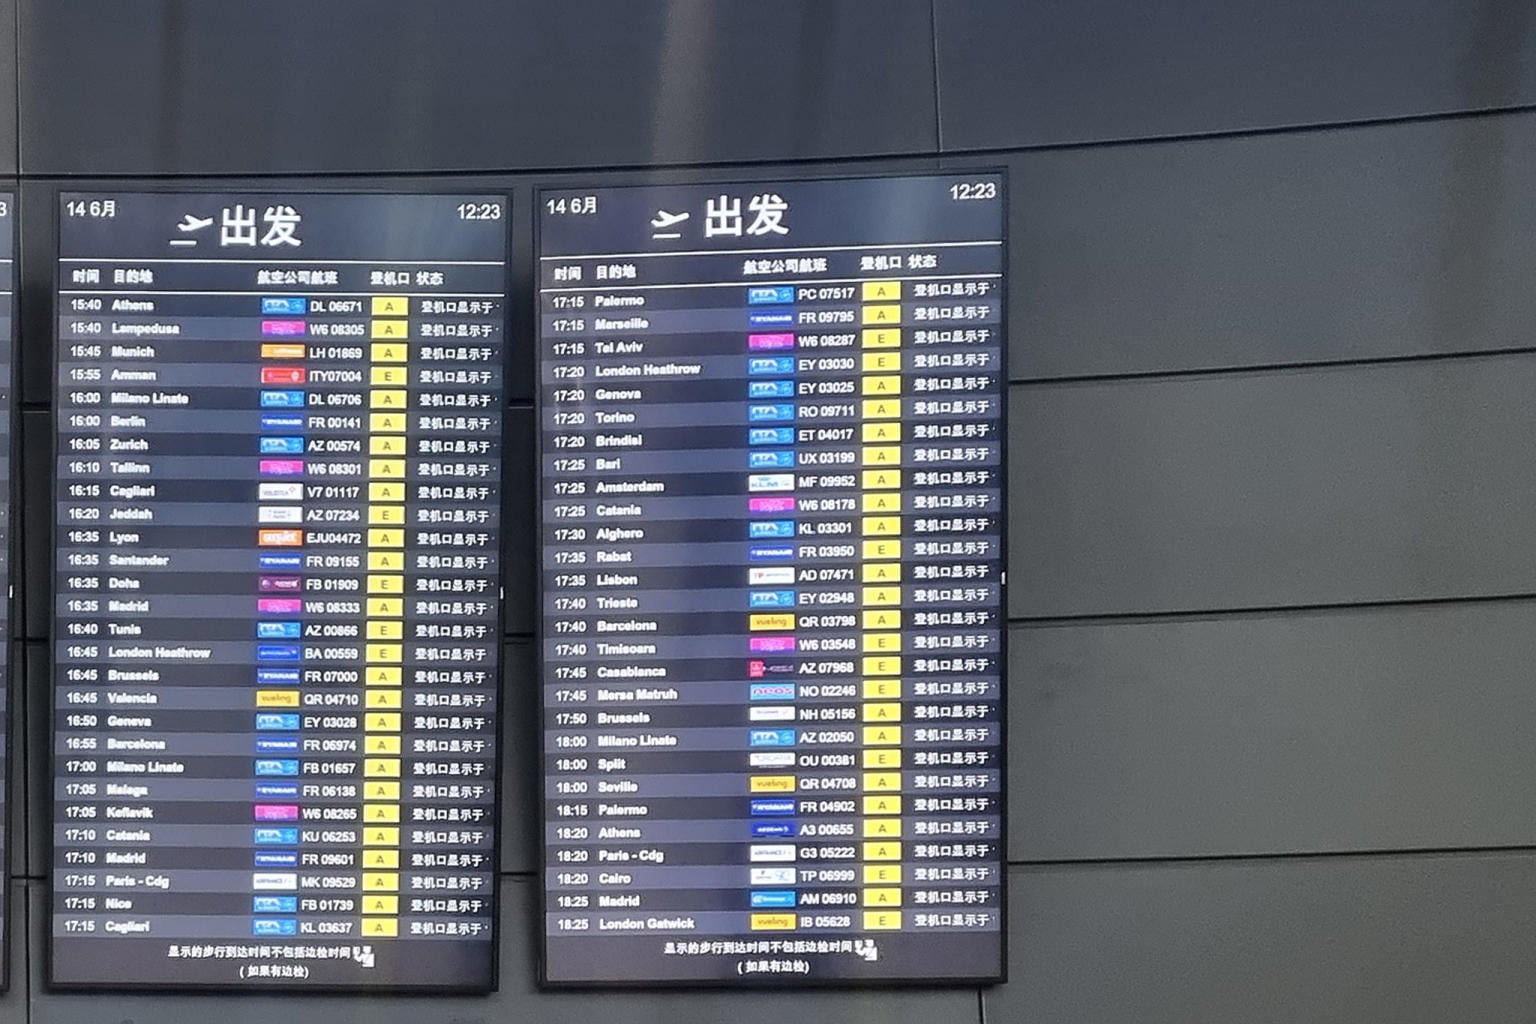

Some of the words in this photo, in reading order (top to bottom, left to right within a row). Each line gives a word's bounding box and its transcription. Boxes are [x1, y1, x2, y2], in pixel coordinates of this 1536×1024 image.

[951, 183, 995, 199] 12:23
[67, 202, 85, 216] 14
[90, 201, 114, 217] 6月
[458, 204, 500, 219] 12:23
[547, 199, 566, 214] 14
[571, 197, 596, 213] 6月
[706, 195, 788, 237] 出发
[221, 205, 301, 246] 出发
[555, 267, 581, 280] 时间
[597, 265, 636, 279] 目的地
[908, 255, 936, 269] 状态
[73, 269, 99, 283] 时间
[114, 269, 153, 283] 目的地
[416, 272, 443, 285] 状态
[553, 297, 584, 307] 17:15
[799, 289, 817, 299] PC
[816, 288, 855, 299] 07517
[877, 287, 886, 296] A
[71, 299, 101, 310] 15:40
[311, 301, 326, 312] DL
[329, 301, 361, 312] 06671
[385, 302, 394, 312] A
[71, 346, 101, 356] 15:45
[553, 343, 584, 354] 17:15
[613, 342, 643, 352] Aviv
[554, 413, 584, 424] 17:20
[595, 413, 634, 423] Torino
[70, 439, 100, 449] 16:05
[308, 441, 328, 451] AZ
[327, 441, 360, 451] 00574
[69, 485, 99, 496] 16:15
[307, 487, 323, 497] V7
[326, 487, 359, 497] 01117
[555, 483, 585, 493] 17:25
[69, 531, 99, 542] 16:35
[555, 575, 585, 586] 17:35
[597, 575, 637, 585] Lisbon
[799, 570, 817, 580] AD
[816, 569, 853, 580] 07471
[68, 647, 97, 657] 16:45
[557, 759, 587, 770] 18:00
[598, 759, 625, 771] Split
[800, 756, 819, 766] OU
[558, 874, 588, 884] 18:20
[65, 898, 95, 908] 17:15
[558, 919, 588, 929] 18:25
